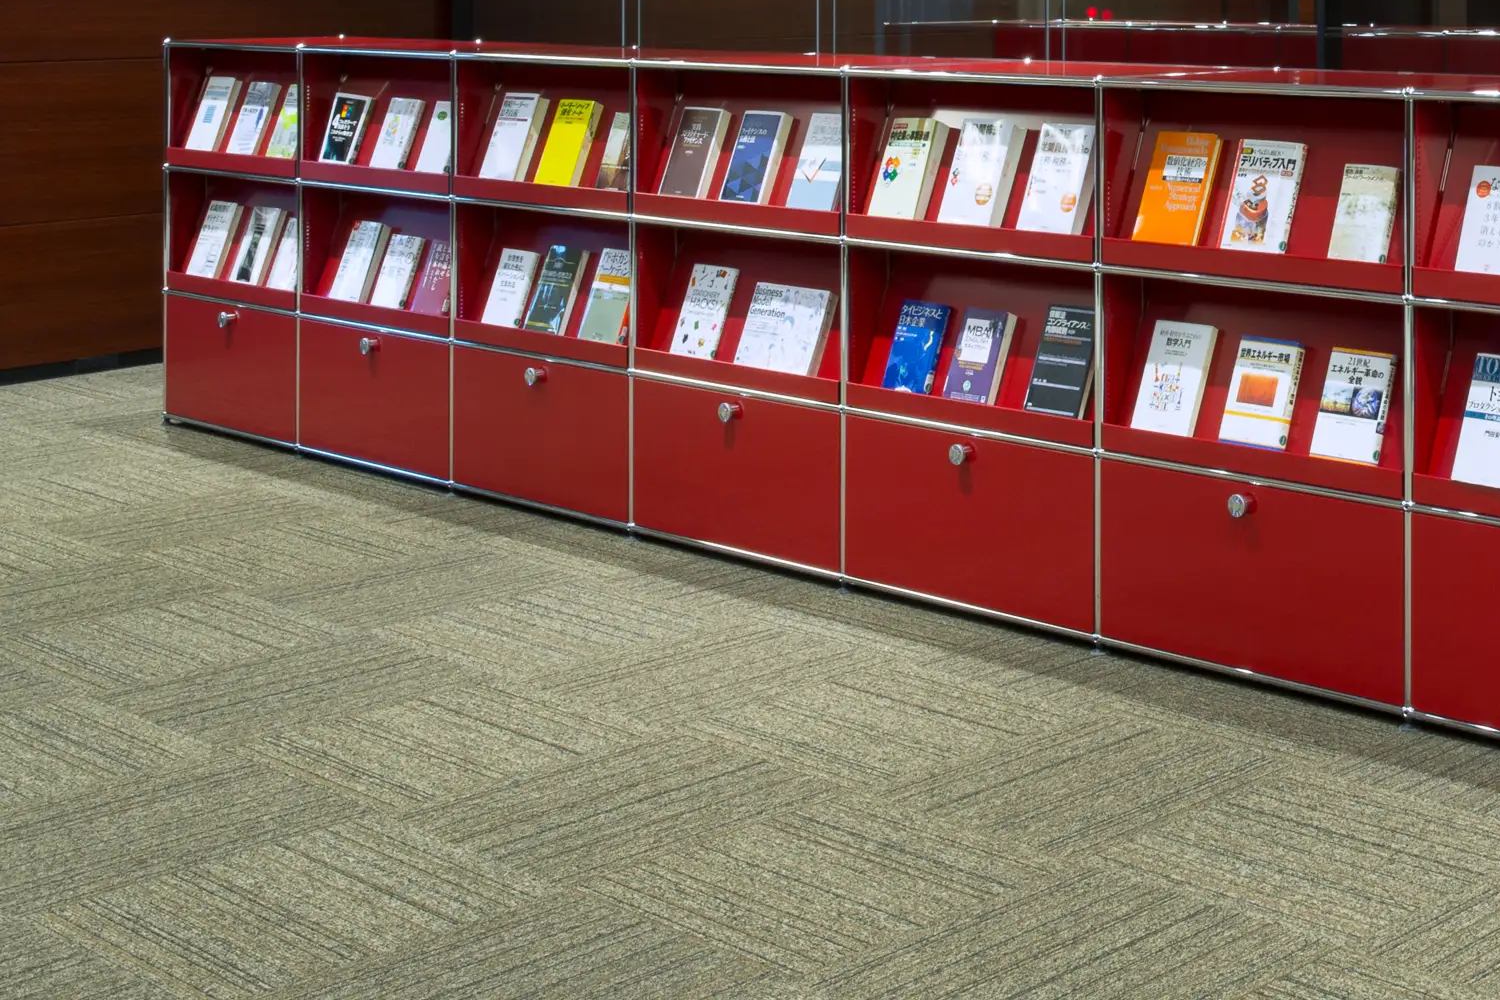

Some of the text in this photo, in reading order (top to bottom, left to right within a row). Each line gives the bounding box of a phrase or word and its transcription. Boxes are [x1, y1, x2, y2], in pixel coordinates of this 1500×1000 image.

[1240, 155, 1297, 171] デリバティブ入門
[755, 285, 783, 298] Business
[753, 295, 773, 307] Model
[750, 305, 786, 318] Generation
[901, 304, 943, 320] タイビジネスと
[898, 314, 926, 328] 日本企業
[1166, 337, 1192, 349] 数学入門
[1240, 347, 1291, 364] 世界エネルギー市場
[1347, 356, 1371, 368] 21世紀
[1331, 364, 1385, 379] エネルギー革命の
